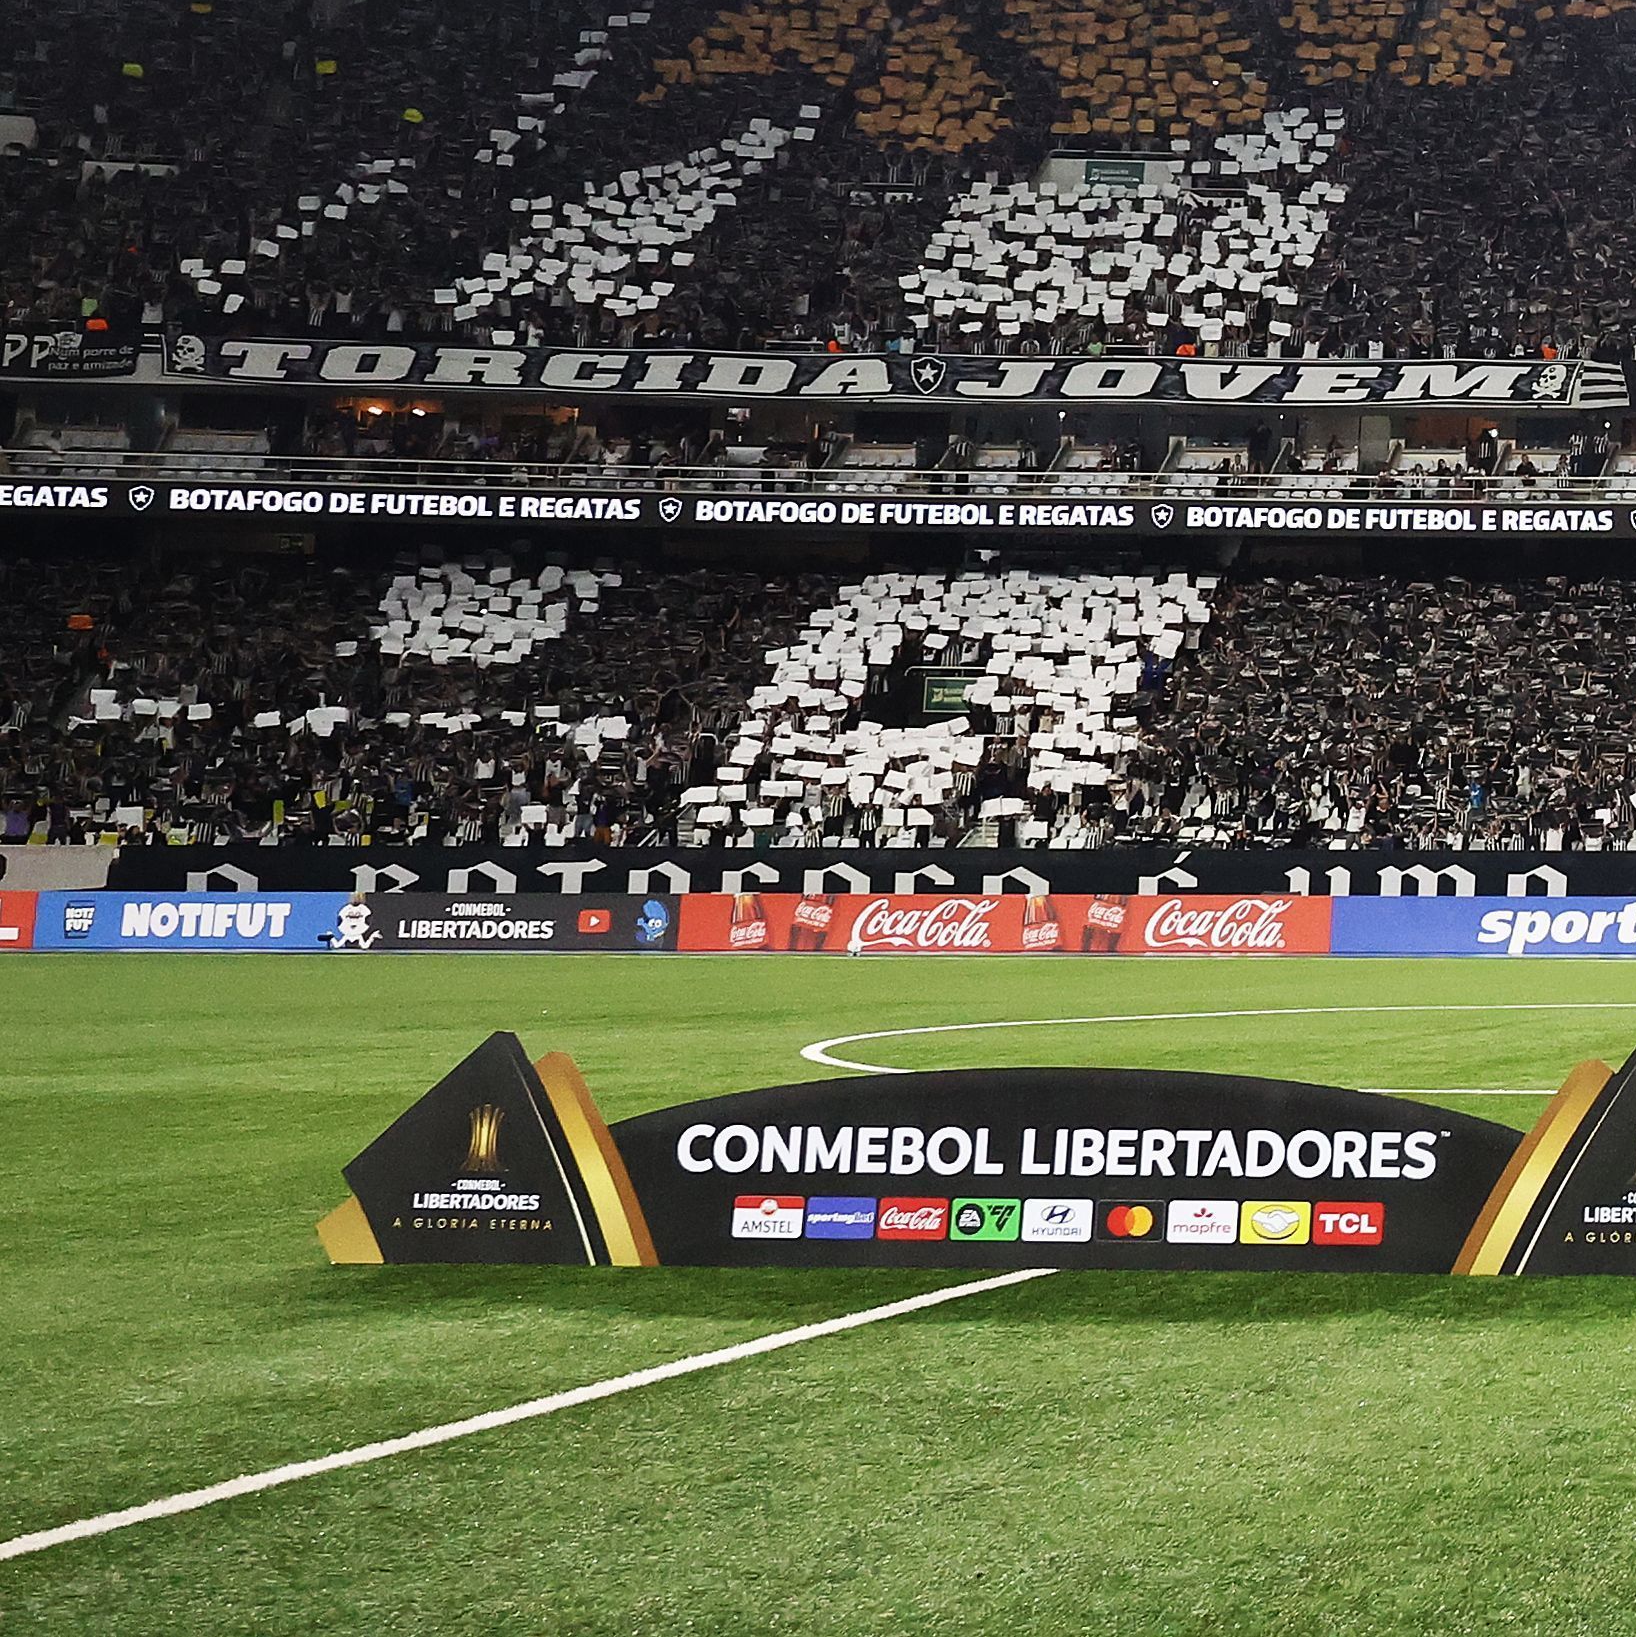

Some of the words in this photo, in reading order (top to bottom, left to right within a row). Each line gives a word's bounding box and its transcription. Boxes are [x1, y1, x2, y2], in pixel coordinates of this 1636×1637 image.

[221, 340, 893, 396] TORCIDA
[955, 361, 1536, 402] JOVEM
[169, 489, 324, 513] BOTAFOGO
[329, 493, 365, 514] DE
[371, 494, 493, 517] FUTEBOL
[498, 497, 516, 516] E
[521, 497, 641, 520] REGATAS
[695, 500, 837, 523] BOTAFOGO
[845, 502, 878, 523] DE
[882, 503, 994, 525] FUTEBOL
[999, 505, 1014, 525] E
[1019, 505, 1134, 526] REGATAS
[1186, 507, 1323, 529] BOTAFOGO
[1327, 509, 1361, 529] DE
[1365, 510, 1477, 531] FUTEBOL
[1482, 510, 1497, 530] E
[1502, 510, 1613, 531] REGATAS
[121, 902, 291, 939] NOTIFUT
[450, 901, 507, 917] CONMEBOL
[398, 917, 557, 941] LIBERTADORES
[852, 897, 991, 949] Coca-Cola
[1145, 897, 1286, 951] Coca-Cola
[677, 1124, 1004, 1176] CONMEBOL
[1020, 1128, 1437, 1181] LIBERTADORES
[412, 1193, 541, 1211] LIBERTADORES
[391, 1217, 403, 1229] A
[489, 1219, 553, 1231] ETERNA
[741, 1220, 793, 1234] AMSTEL
[807, 1212, 875, 1225] sportingbet
[879, 1206, 946, 1230] Coca-Cola
[1172, 1221, 1232, 1235] mapfre
[1319, 1212, 1378, 1235] TCL
[1032, 1227, 1082, 1236] HYUNDAI
[1564, 1232, 1575, 1243] A
